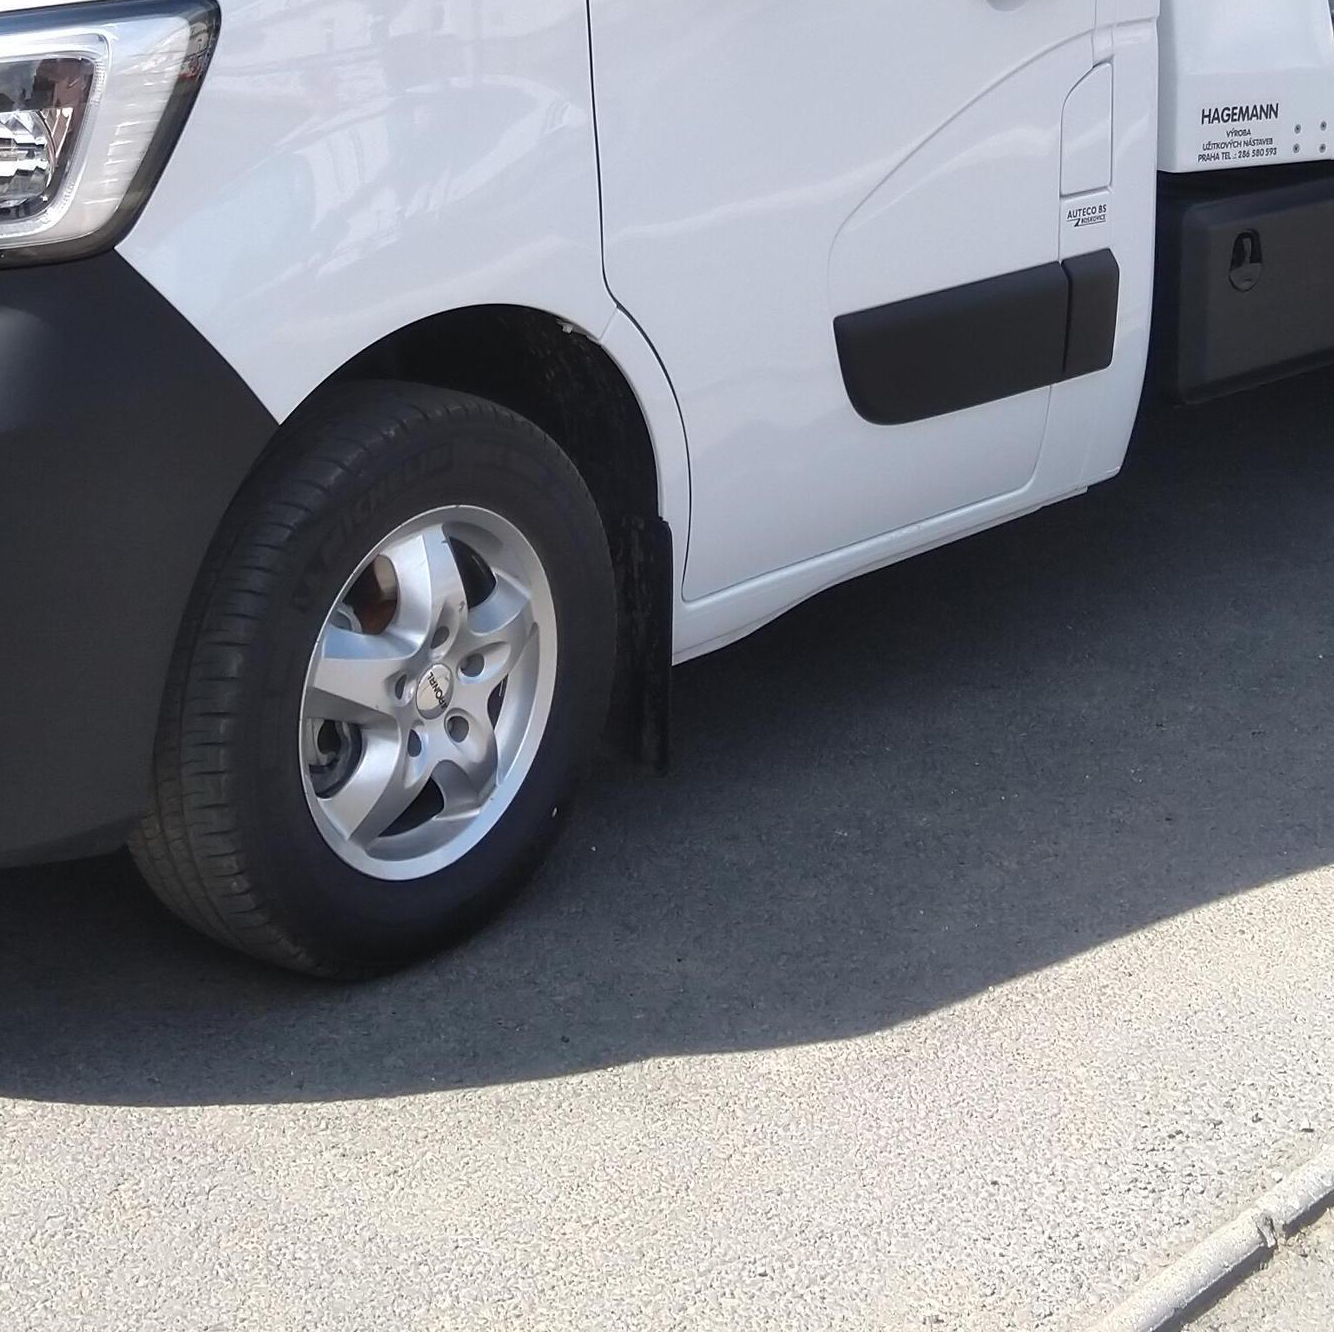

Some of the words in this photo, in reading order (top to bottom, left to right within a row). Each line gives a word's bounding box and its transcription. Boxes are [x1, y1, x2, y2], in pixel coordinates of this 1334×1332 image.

[1201, 102, 1279, 125] HAGEMANN
[1226, 127, 1251, 138] VÝROBA
[1202, 139, 1242, 151] UŽITKOVÝCH
[1198, 152, 1220, 162] PRAHA
[1067, 206, 1097, 219] AUTECO
